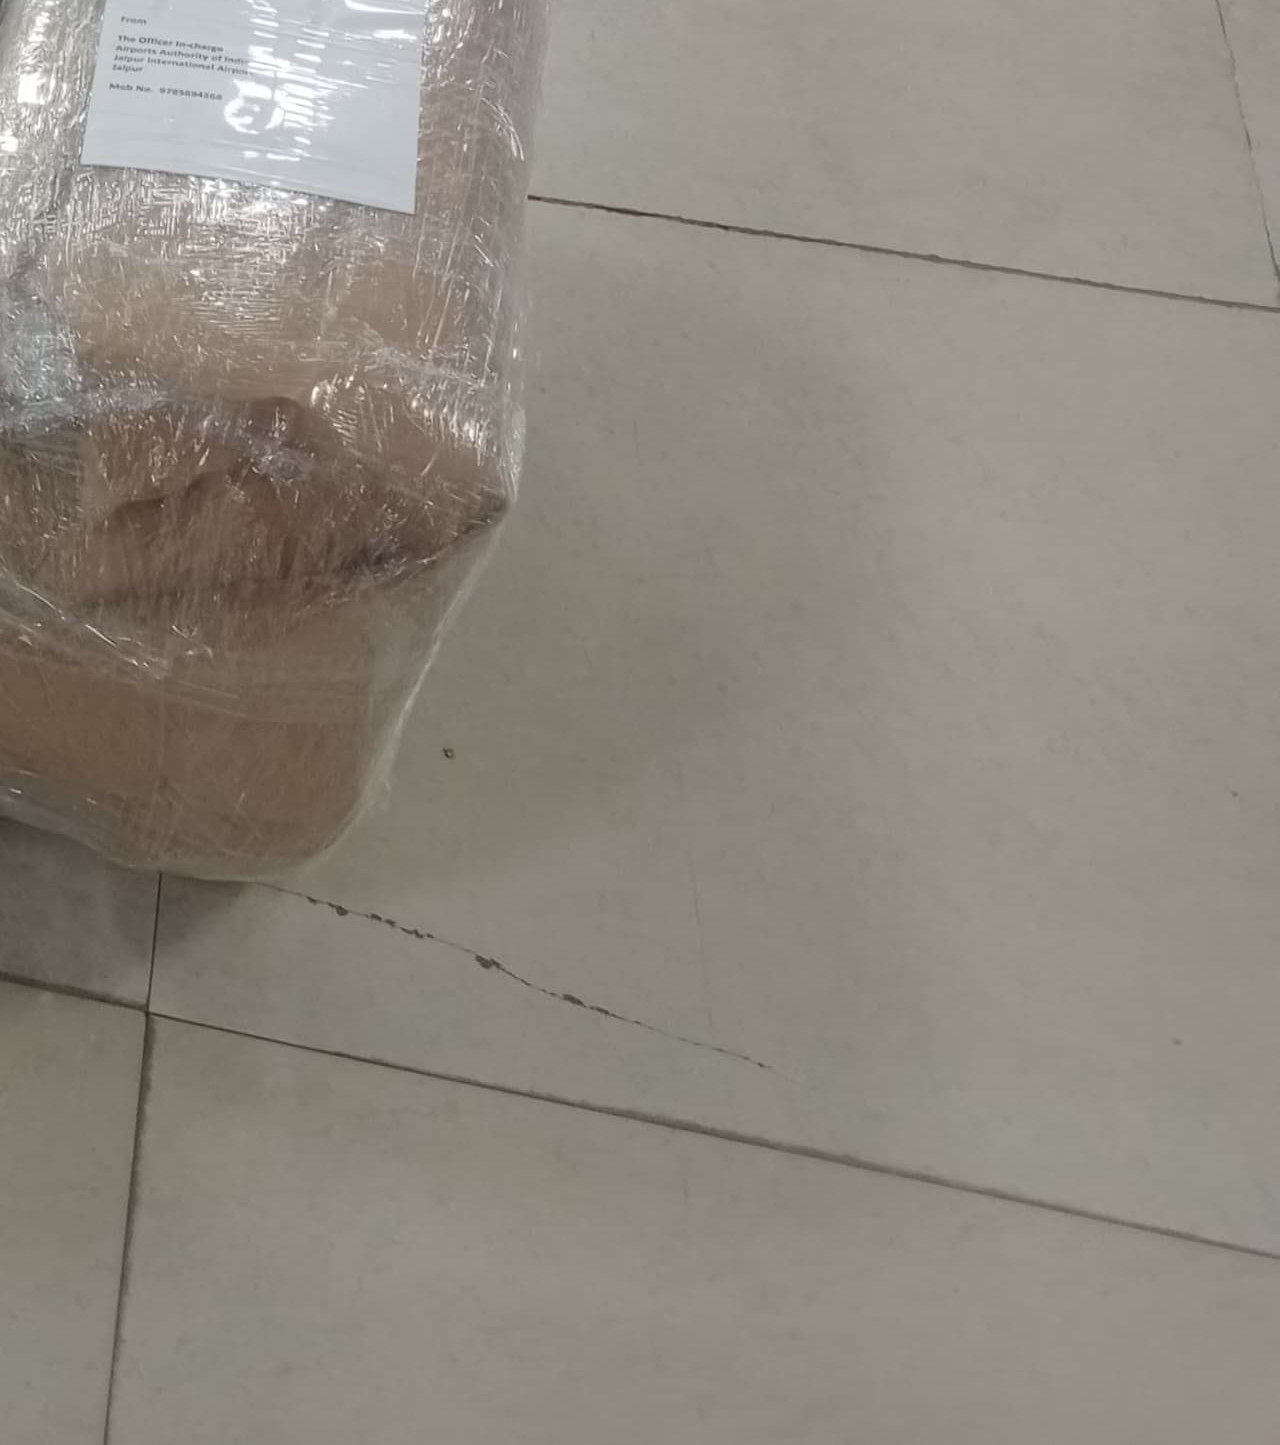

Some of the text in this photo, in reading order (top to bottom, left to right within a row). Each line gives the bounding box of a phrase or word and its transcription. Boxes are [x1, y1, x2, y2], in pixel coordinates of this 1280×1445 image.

[121, 16, 147, 25] From
[139, 37, 173, 46] Officer
[116, 45, 157, 55] Airports
[160, 50, 209, 61] Authority
[114, 55, 144, 63] Jaipur
[147, 58, 214, 70] International
[112, 64, 143, 73] Jaipur
[109, 83, 133, 91] Mob
